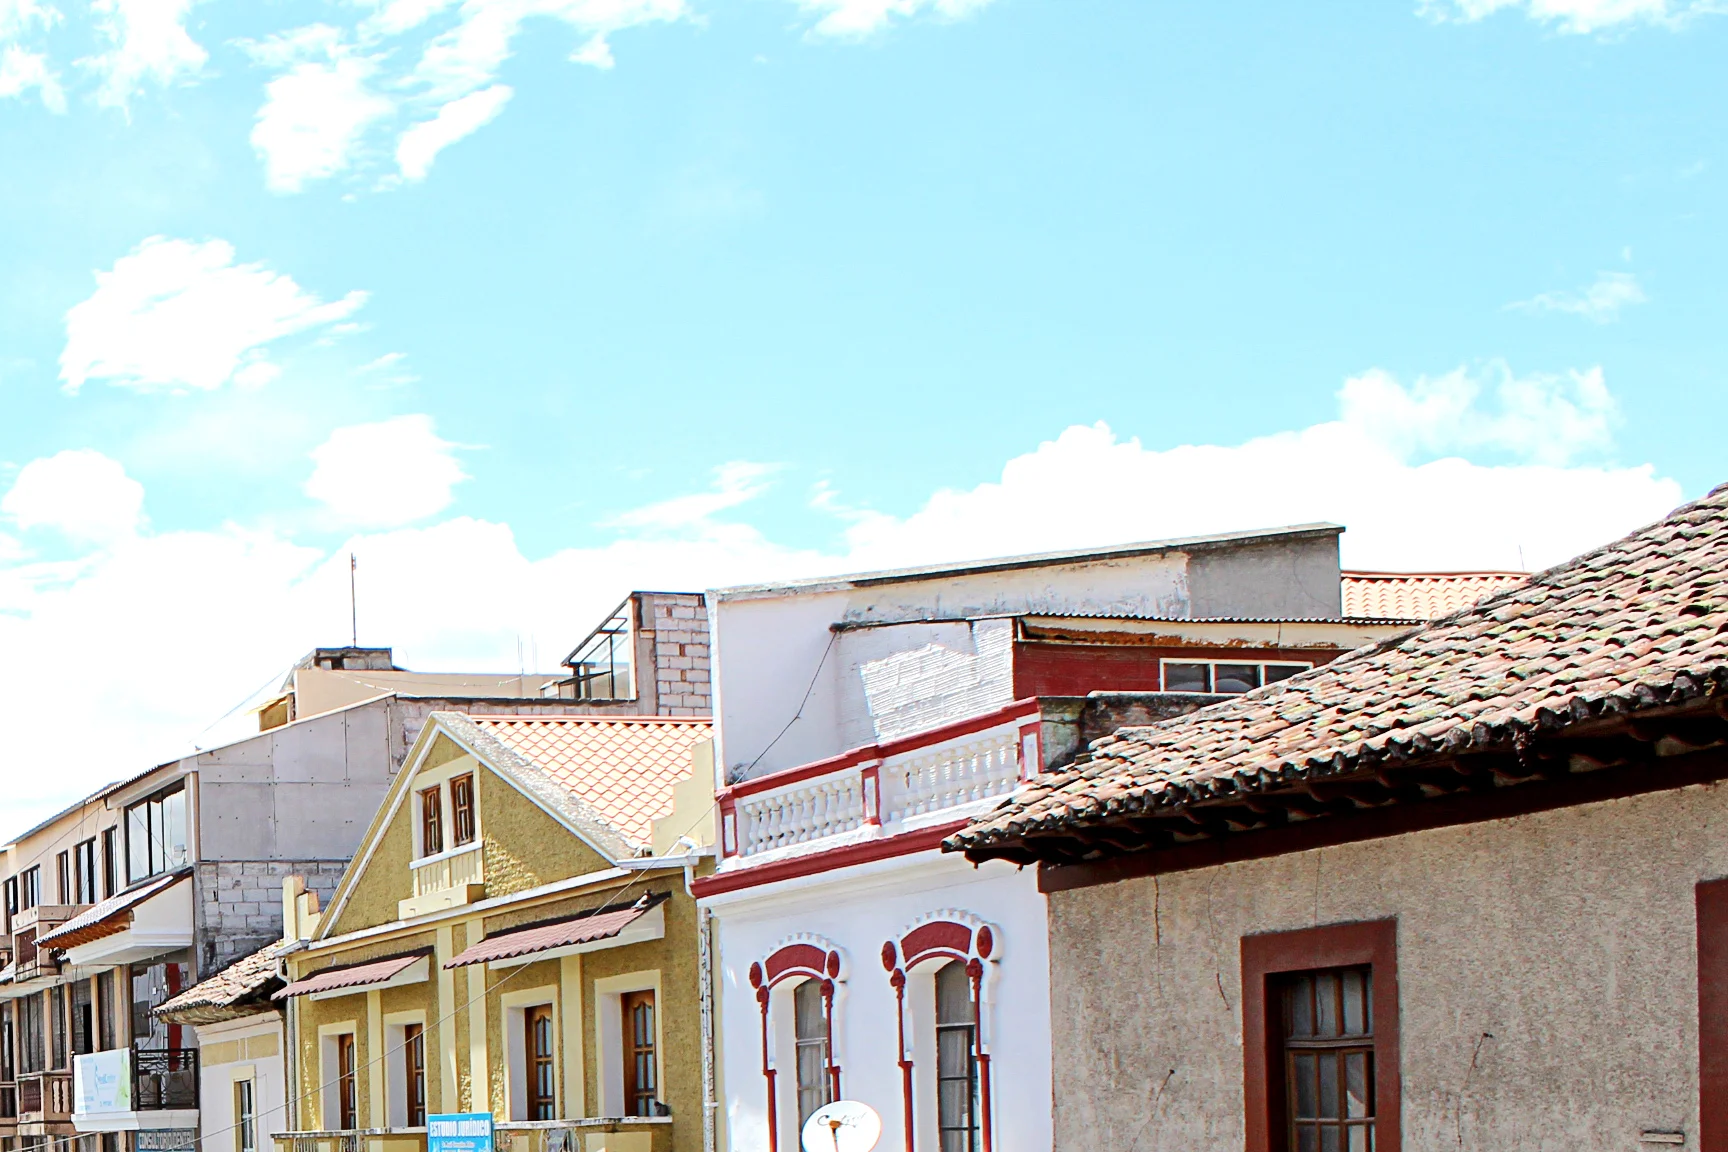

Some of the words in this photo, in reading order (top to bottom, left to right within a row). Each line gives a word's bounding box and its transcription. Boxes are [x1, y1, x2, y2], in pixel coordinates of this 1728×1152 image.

[429, 1120, 458, 1137] ESTUDIO
[458, 1117, 490, 1137] JURÍDICO
[139, 1132, 172, 1150] CONSULTORIO
